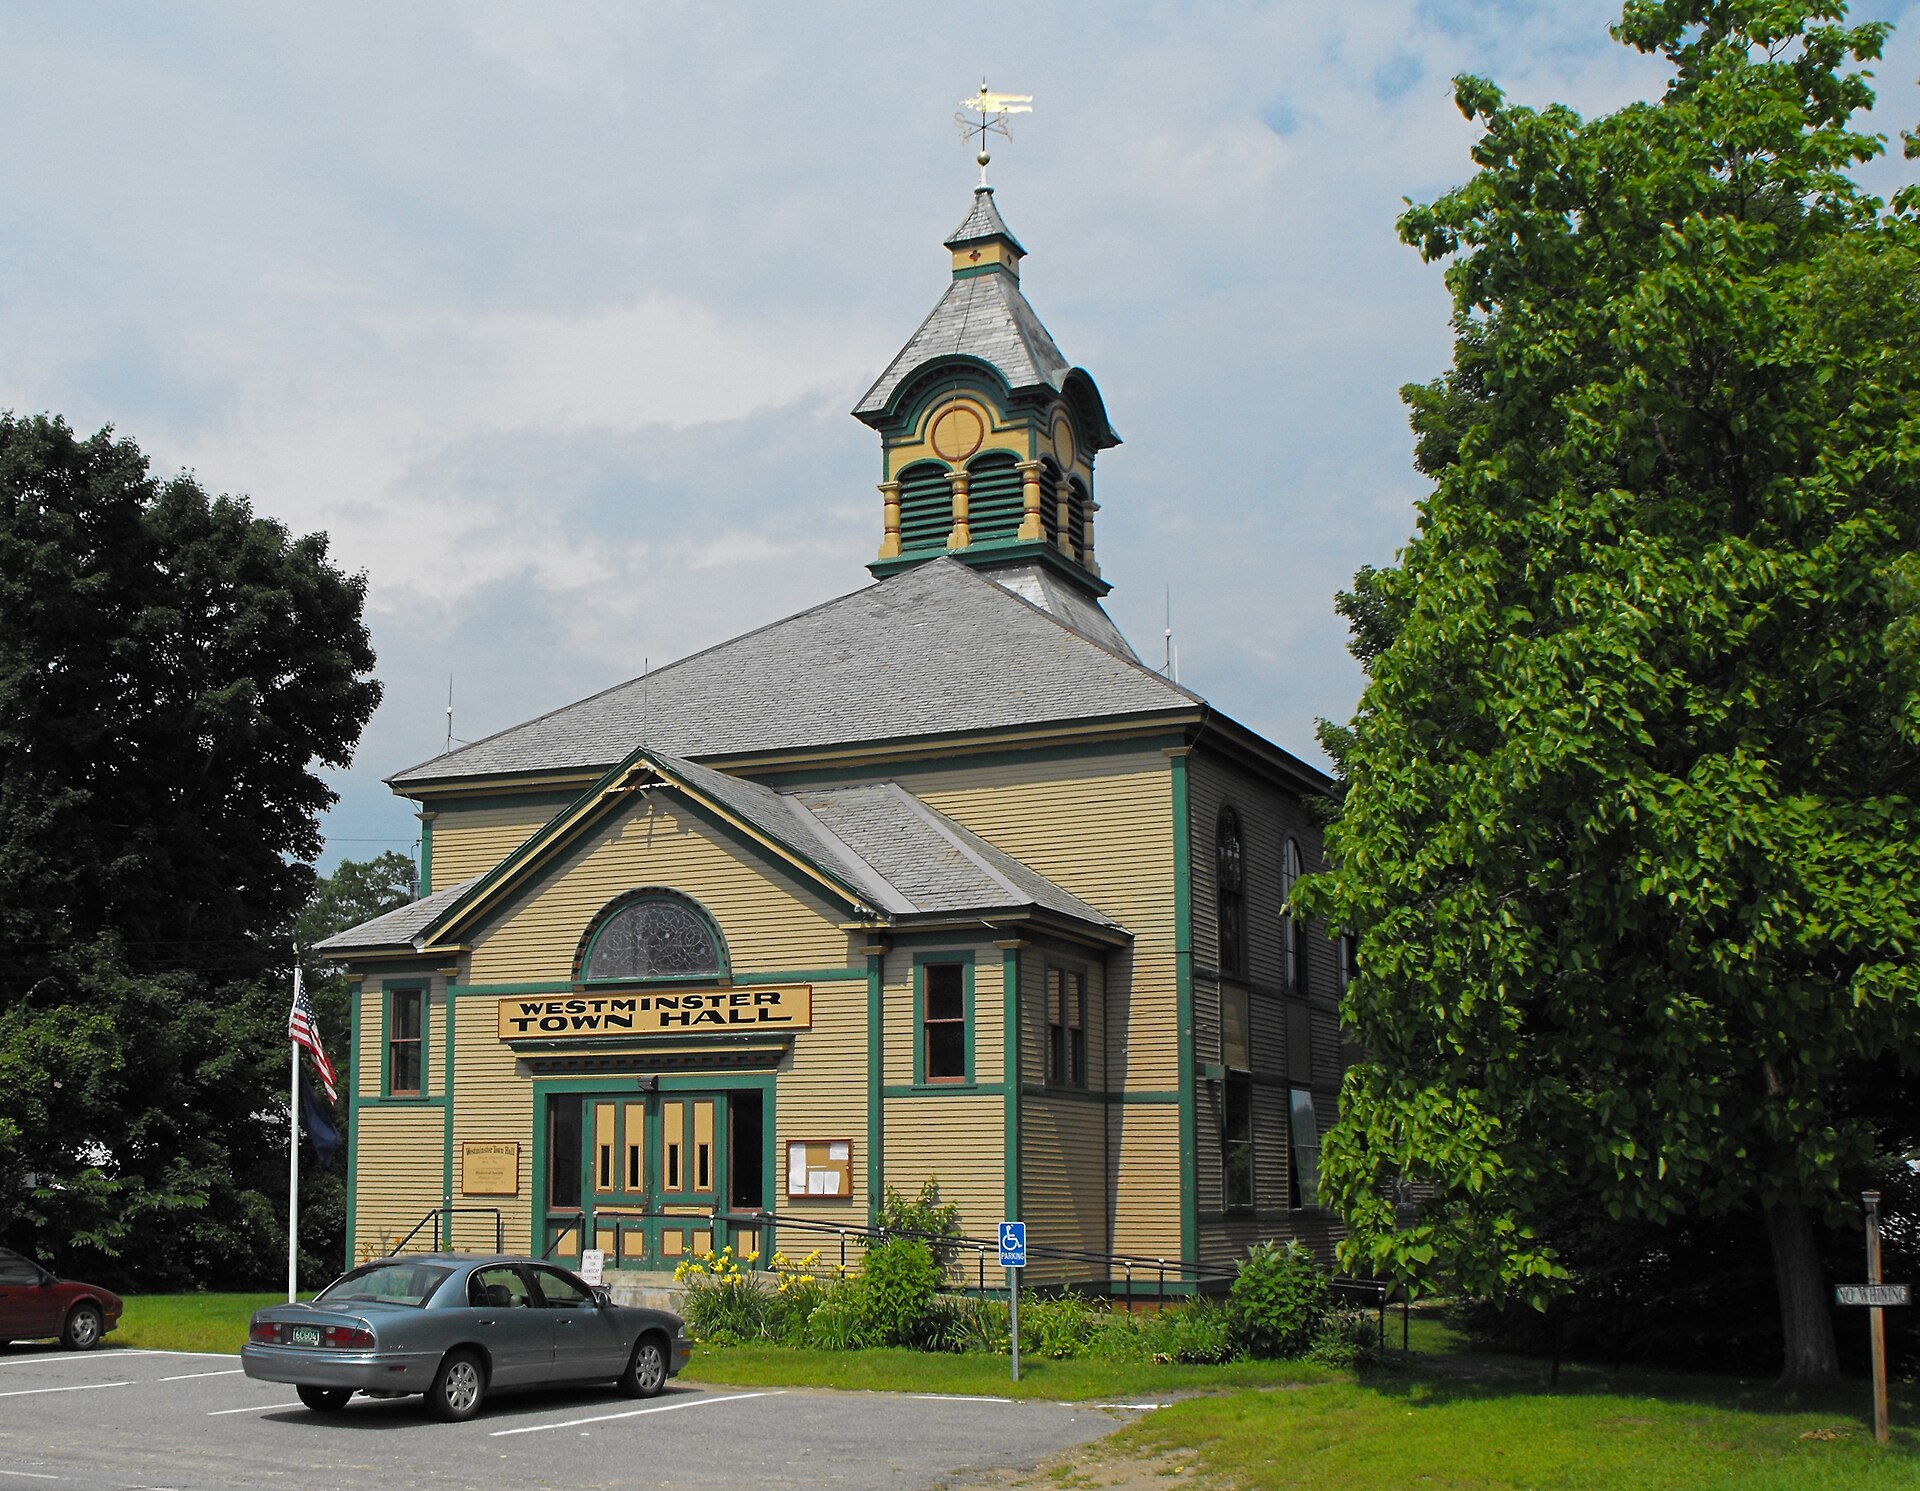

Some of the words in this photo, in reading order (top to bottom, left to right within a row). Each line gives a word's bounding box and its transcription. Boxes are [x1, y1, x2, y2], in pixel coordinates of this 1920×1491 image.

[519, 991, 782, 1015] WESTMINSTER
[509, 1013, 633, 1032] TOWN
[659, 1007, 792, 1027] HALL
[1001, 1252, 1024, 1260] PARKING
[1838, 1287, 1855, 1303] NO
[1858, 1287, 1906, 1303] WHINING
